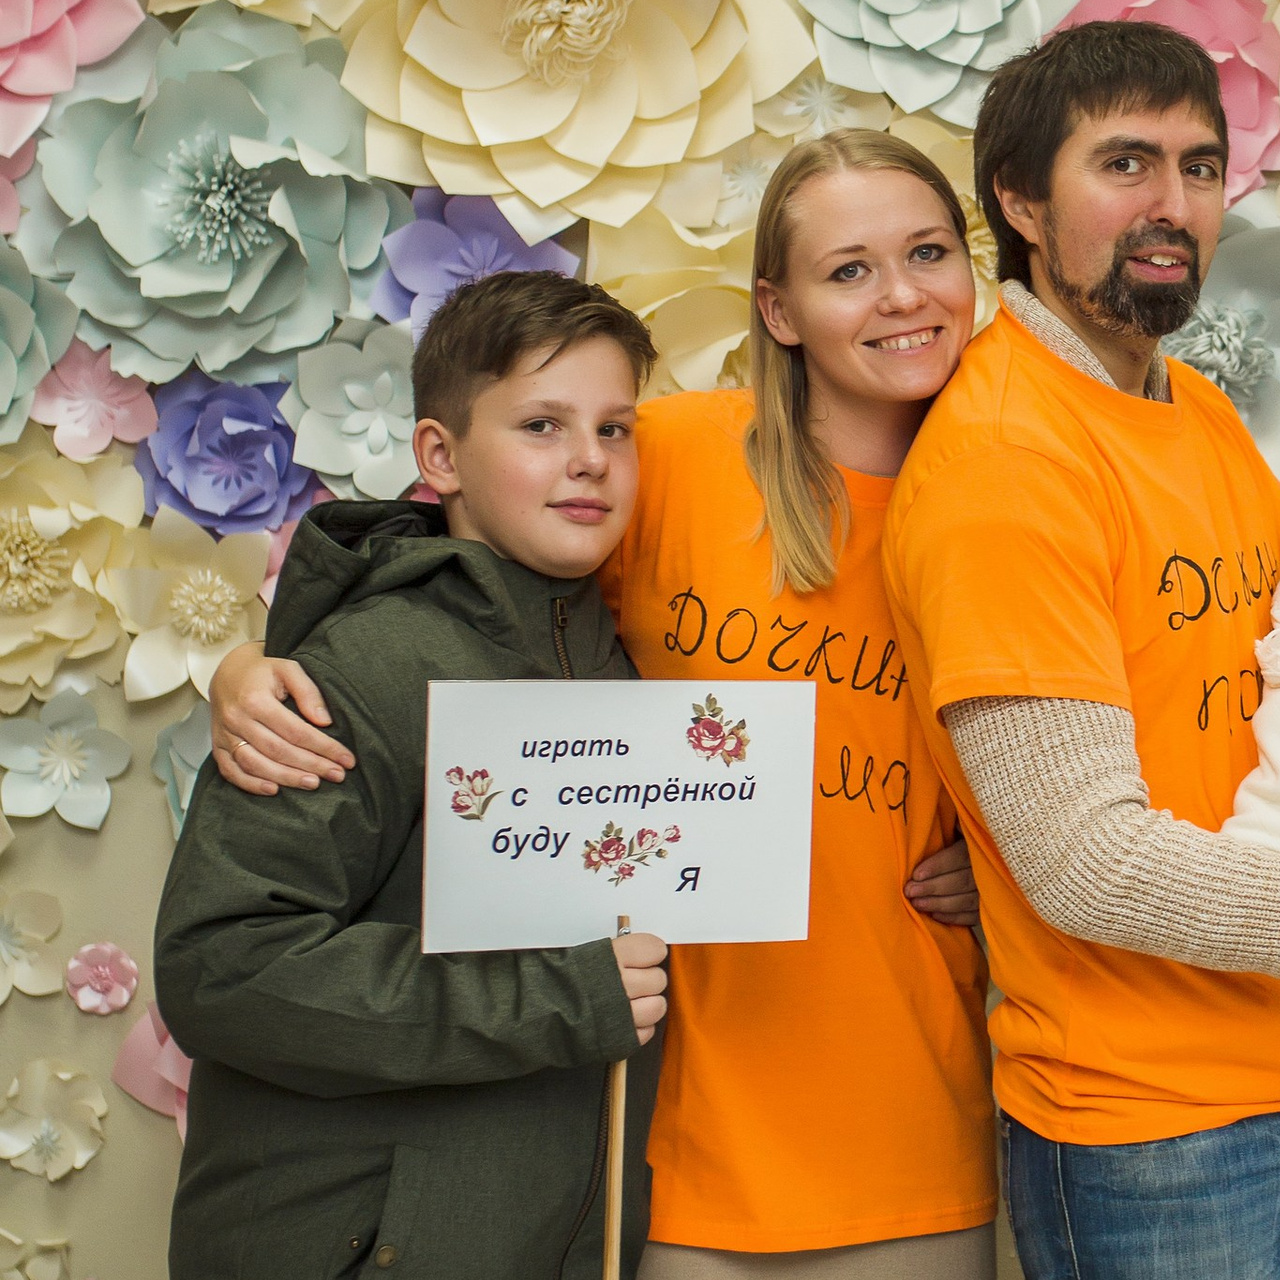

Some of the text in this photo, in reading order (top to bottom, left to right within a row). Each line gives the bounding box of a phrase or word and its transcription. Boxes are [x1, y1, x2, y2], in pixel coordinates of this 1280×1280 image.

[521, 737, 630, 763] играть
[511, 775, 757, 809] с сестрёнкой
[491, 825, 571, 860] буду
